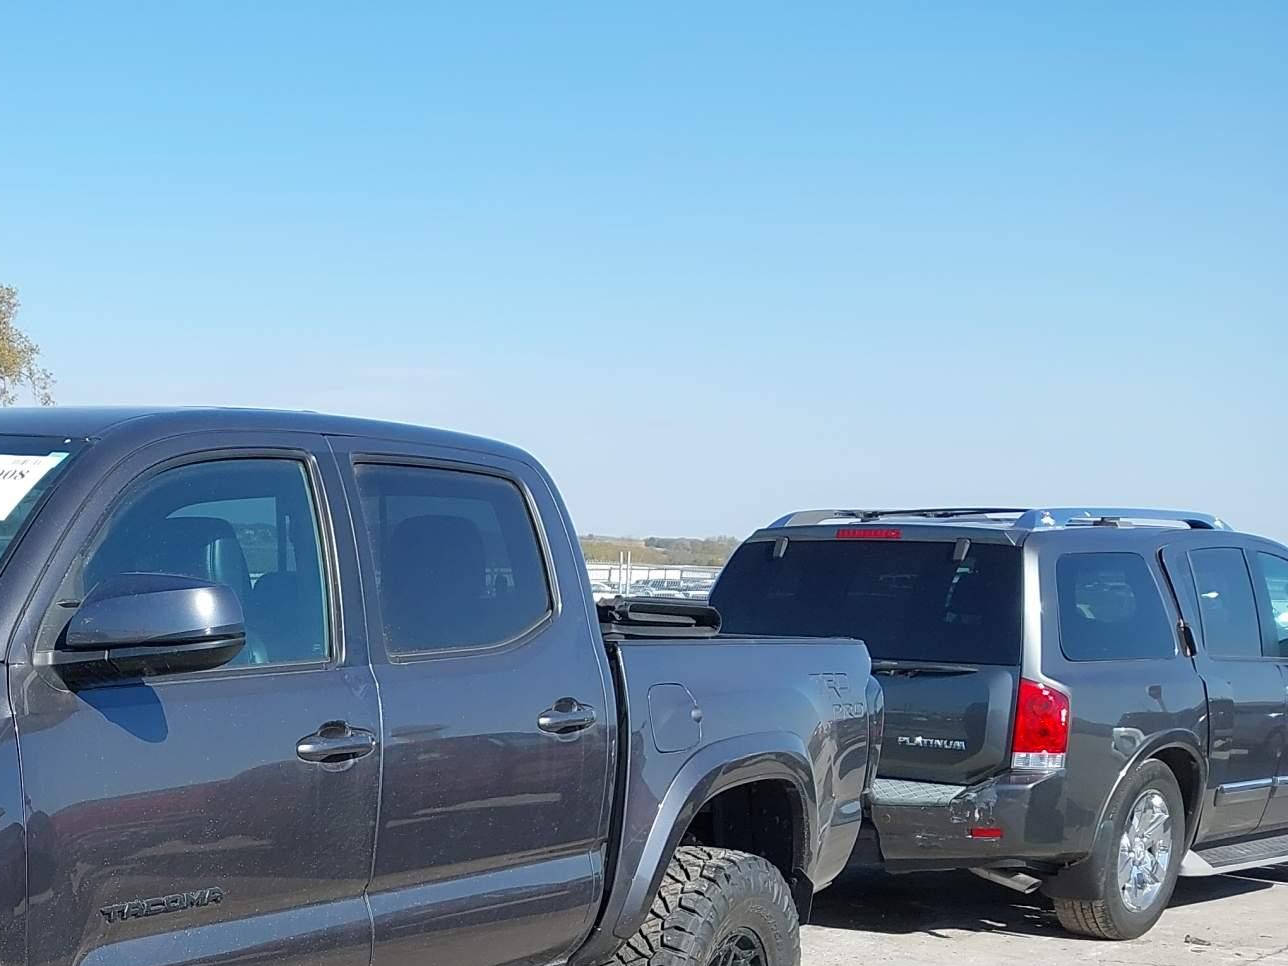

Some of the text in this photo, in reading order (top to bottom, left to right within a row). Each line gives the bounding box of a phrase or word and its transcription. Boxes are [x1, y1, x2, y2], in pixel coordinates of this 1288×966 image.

[808, 672, 850, 698] TRD
[833, 703, 864, 719] PRO
[897, 735, 966, 751] PLATINUM
[100, 886, 224, 924] TACOMA
